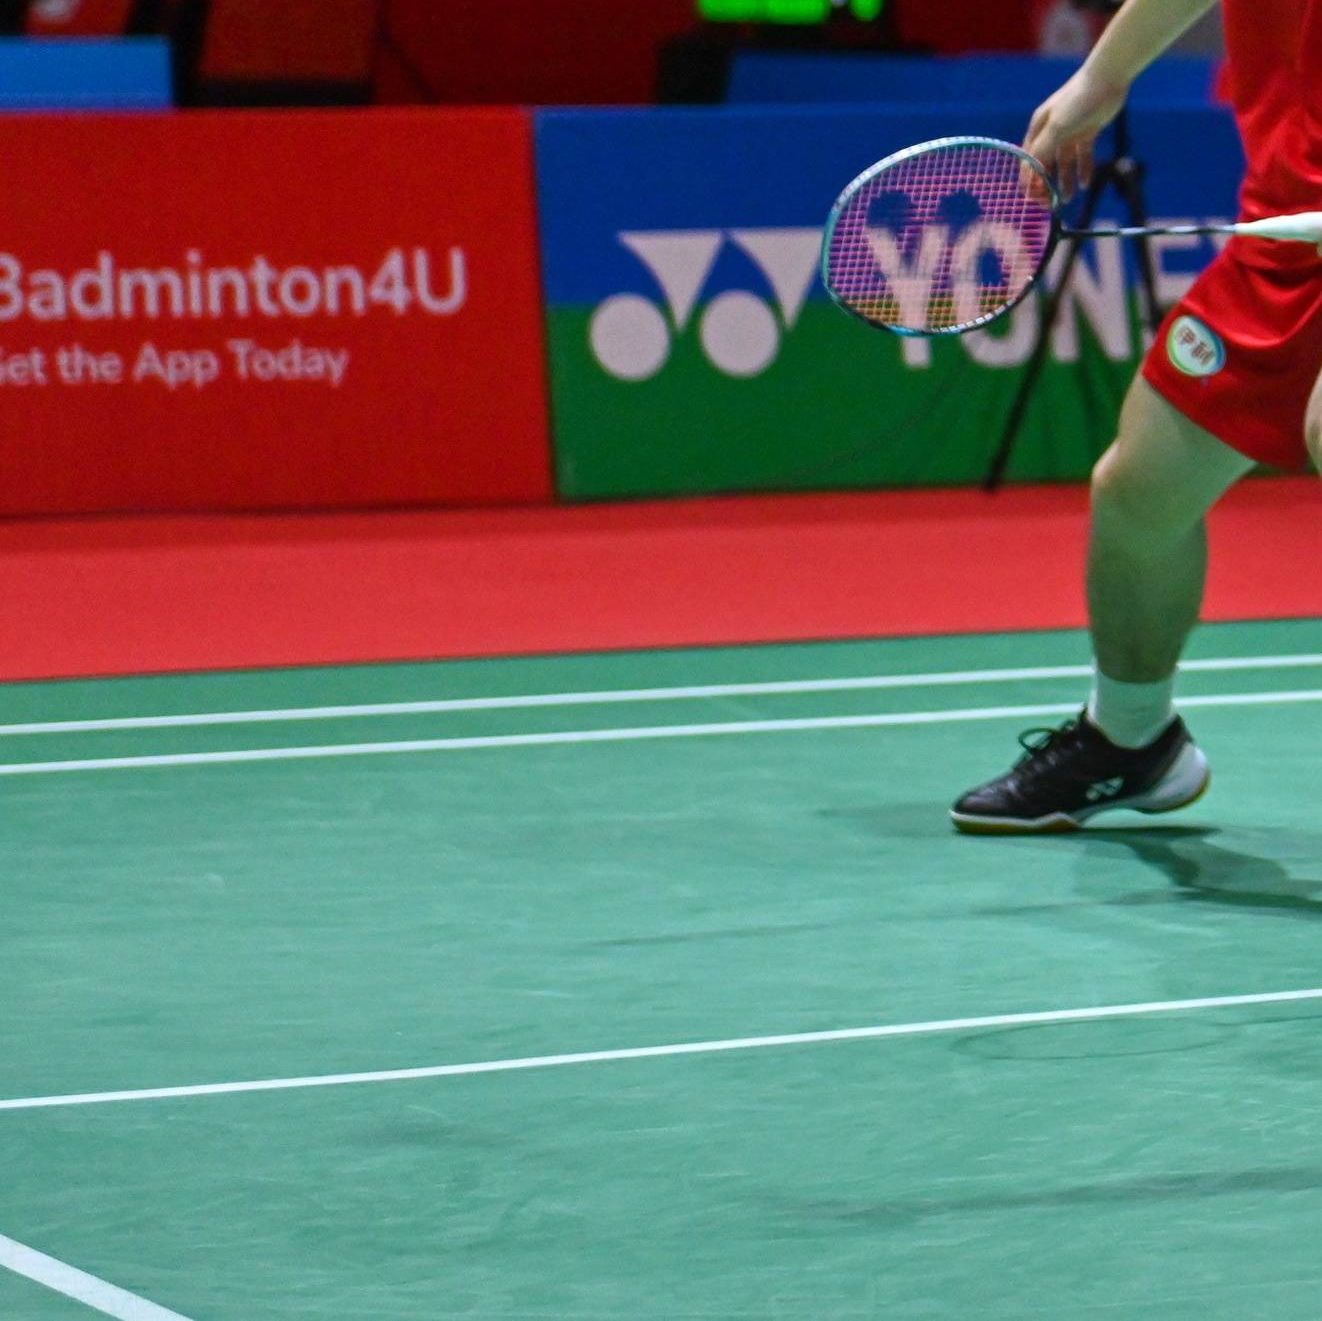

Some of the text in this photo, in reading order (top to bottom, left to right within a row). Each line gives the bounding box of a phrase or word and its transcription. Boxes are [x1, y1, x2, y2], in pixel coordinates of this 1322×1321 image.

[0, 246, 467, 322] Badminton4U
[865, 216, 1230, 369] YONE
[0, 337, 350, 391] et the App Today
